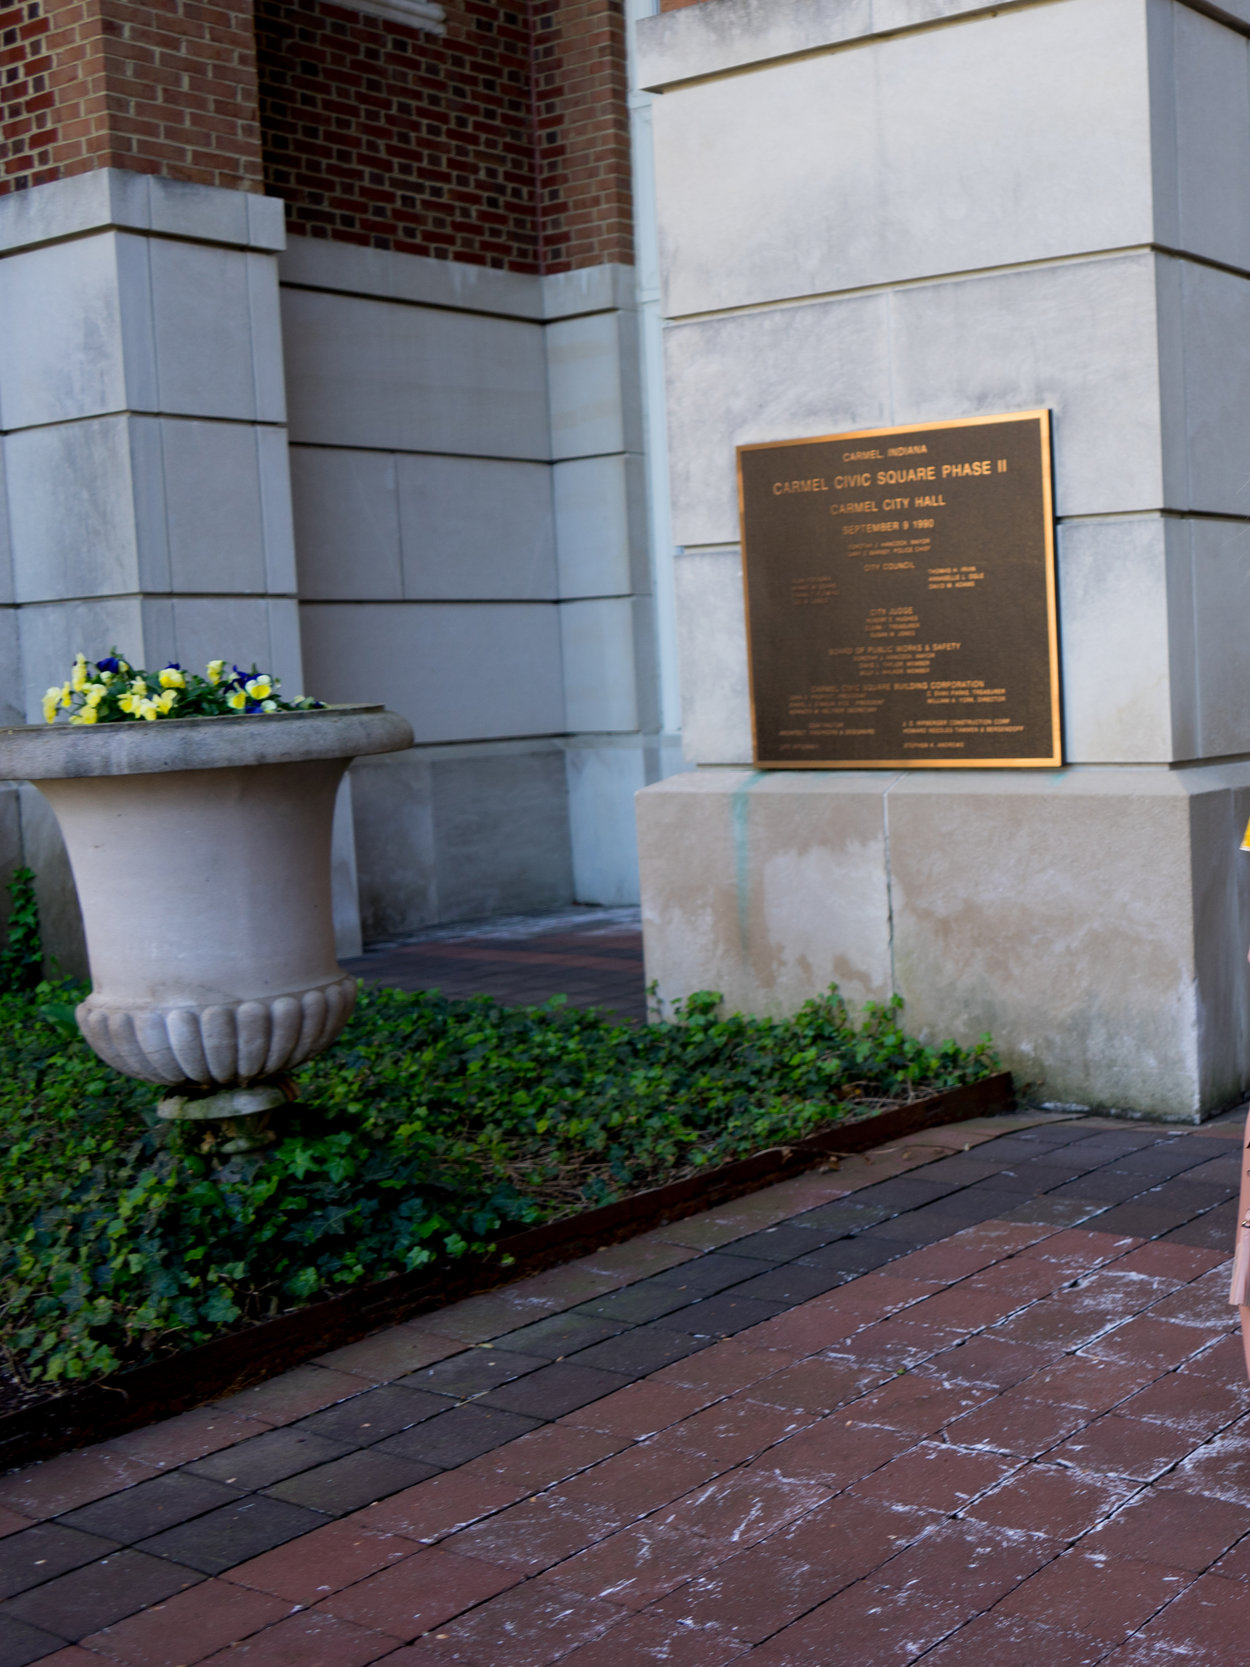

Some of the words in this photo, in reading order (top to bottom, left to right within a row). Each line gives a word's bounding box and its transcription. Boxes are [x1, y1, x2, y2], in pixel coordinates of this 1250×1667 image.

[887, 444, 928, 457] INDIANA
[772, 478, 829, 495] CARMEL
[834, 472, 872, 489] CIVIC
[877, 466, 936, 485] SQUARE
[942, 460, 992, 478] PHASE
[997, 459, 1008, 473] II
[830, 501, 879, 515] CARMEL
[883, 497, 910, 511] CITY
[914, 494, 947, 507] HALL
[842, 521, 899, 535] SEPTEMBER
[932, 642, 961, 652] SAFETY
[930, 680, 984, 689] CORPORATION
